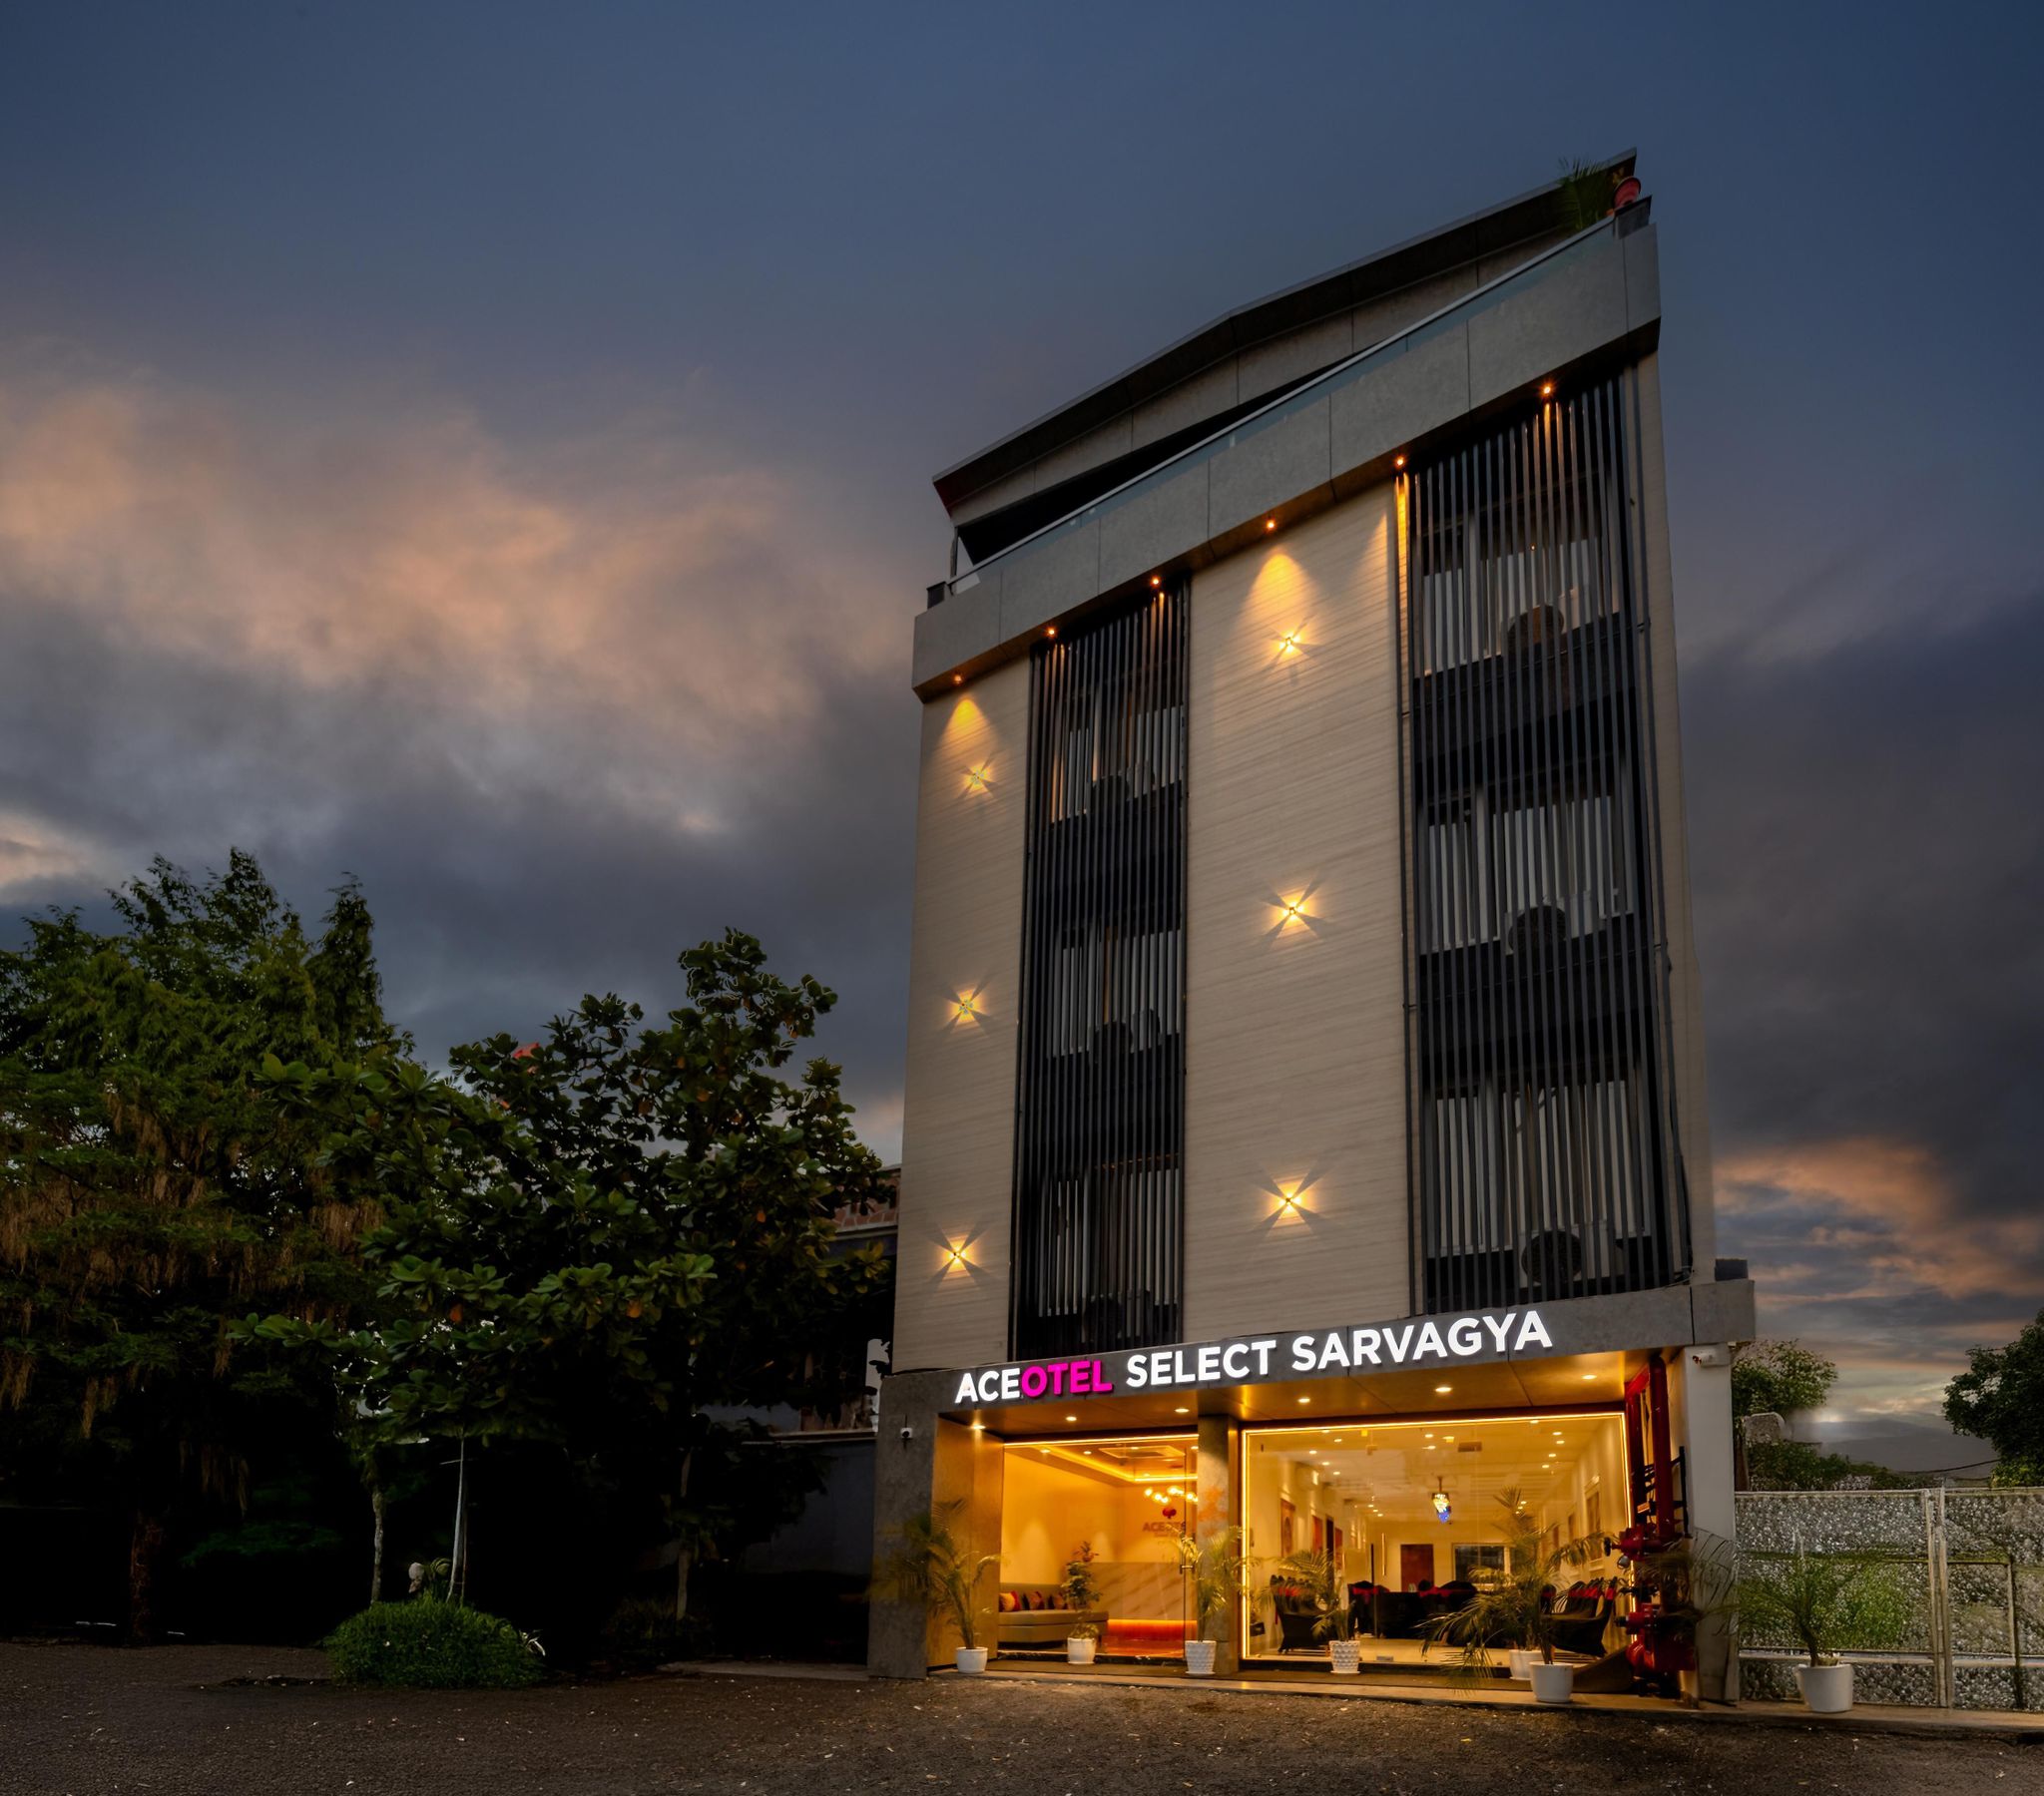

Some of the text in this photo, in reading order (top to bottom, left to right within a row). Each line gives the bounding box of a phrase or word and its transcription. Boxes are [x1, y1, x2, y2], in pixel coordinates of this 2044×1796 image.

[955, 1310, 1553, 1403] ACEOTEL SELECT SARVAGYA
